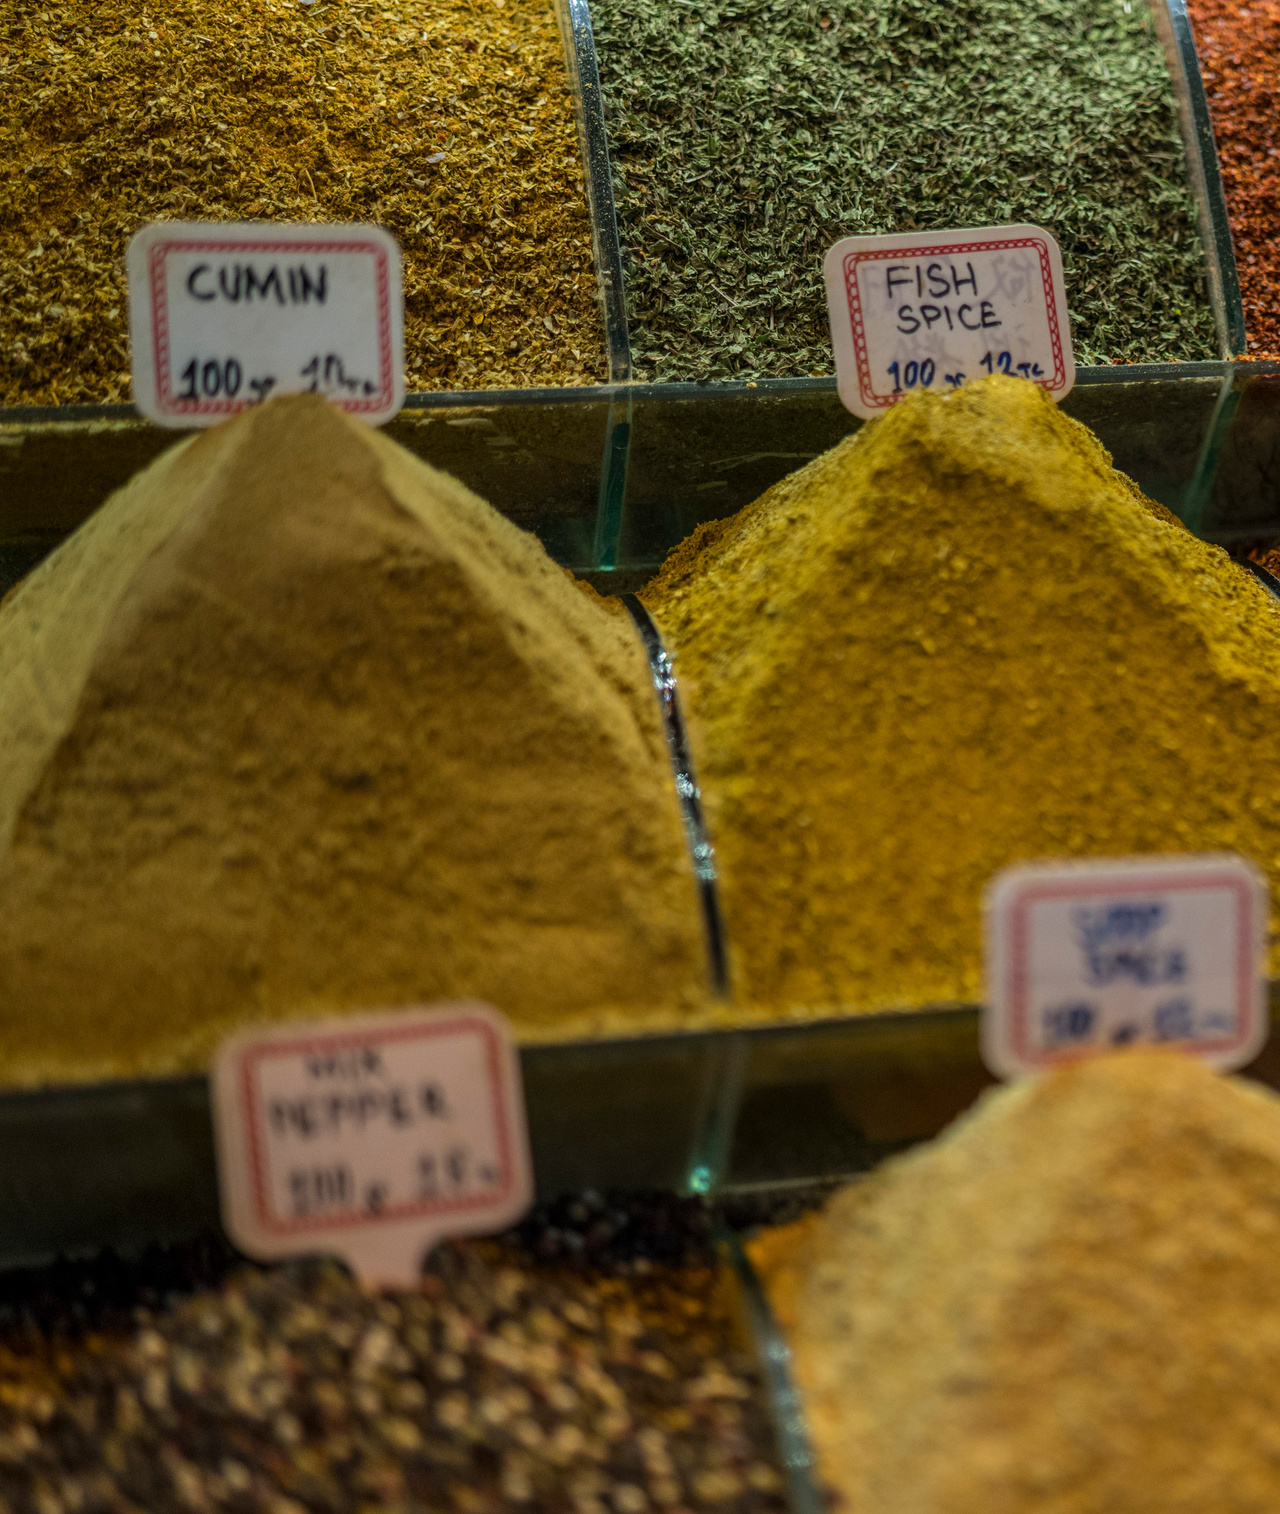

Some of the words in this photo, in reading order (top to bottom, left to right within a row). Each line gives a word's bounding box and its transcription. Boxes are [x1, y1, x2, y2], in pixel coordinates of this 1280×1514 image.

[186, 262, 328, 306] CUMIN
[885, 262, 979, 299] FISH
[897, 301, 1002, 335] SPICE
[178, 357, 244, 404] 100
[887, 358, 936, 394] 100
